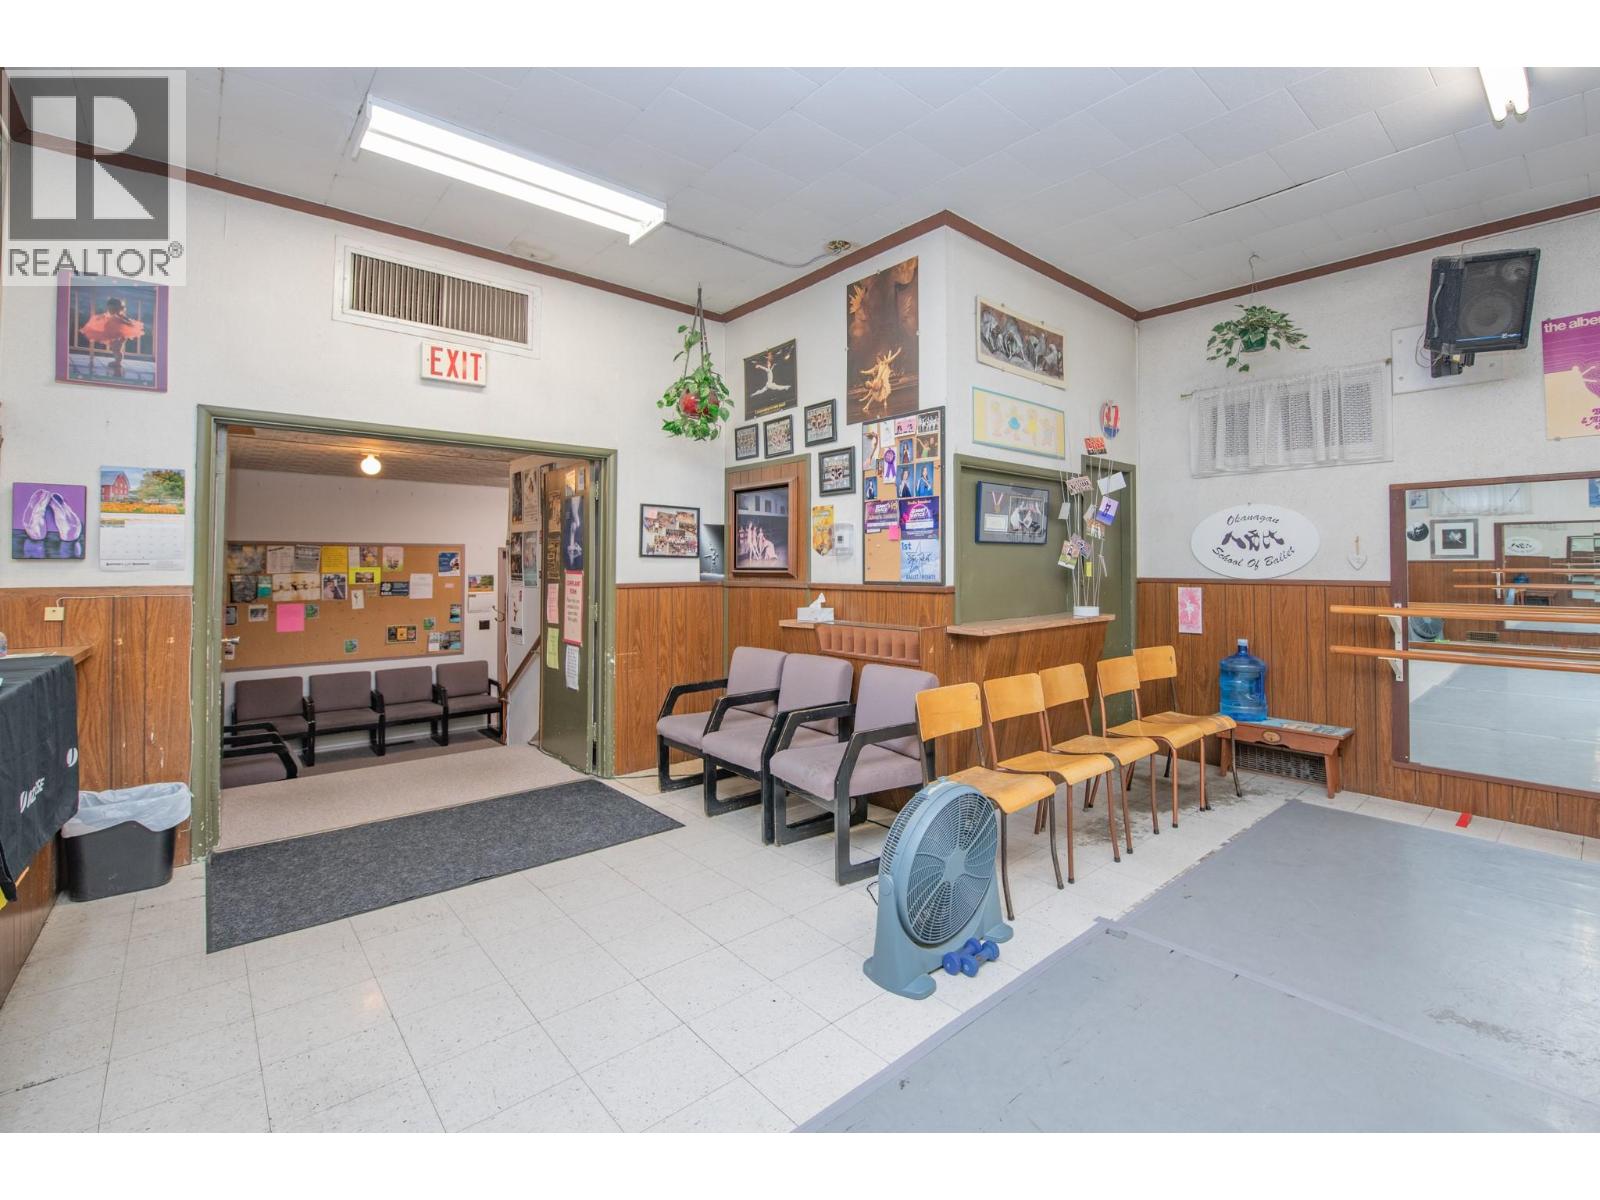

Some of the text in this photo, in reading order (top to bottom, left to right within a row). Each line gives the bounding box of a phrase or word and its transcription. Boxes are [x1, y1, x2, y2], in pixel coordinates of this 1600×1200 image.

[1544, 322, 1567, 333] the
[430, 345, 482, 381] EXIT
[1212, 546, 1242, 567] School
[1247, 558, 1260, 571] Of
